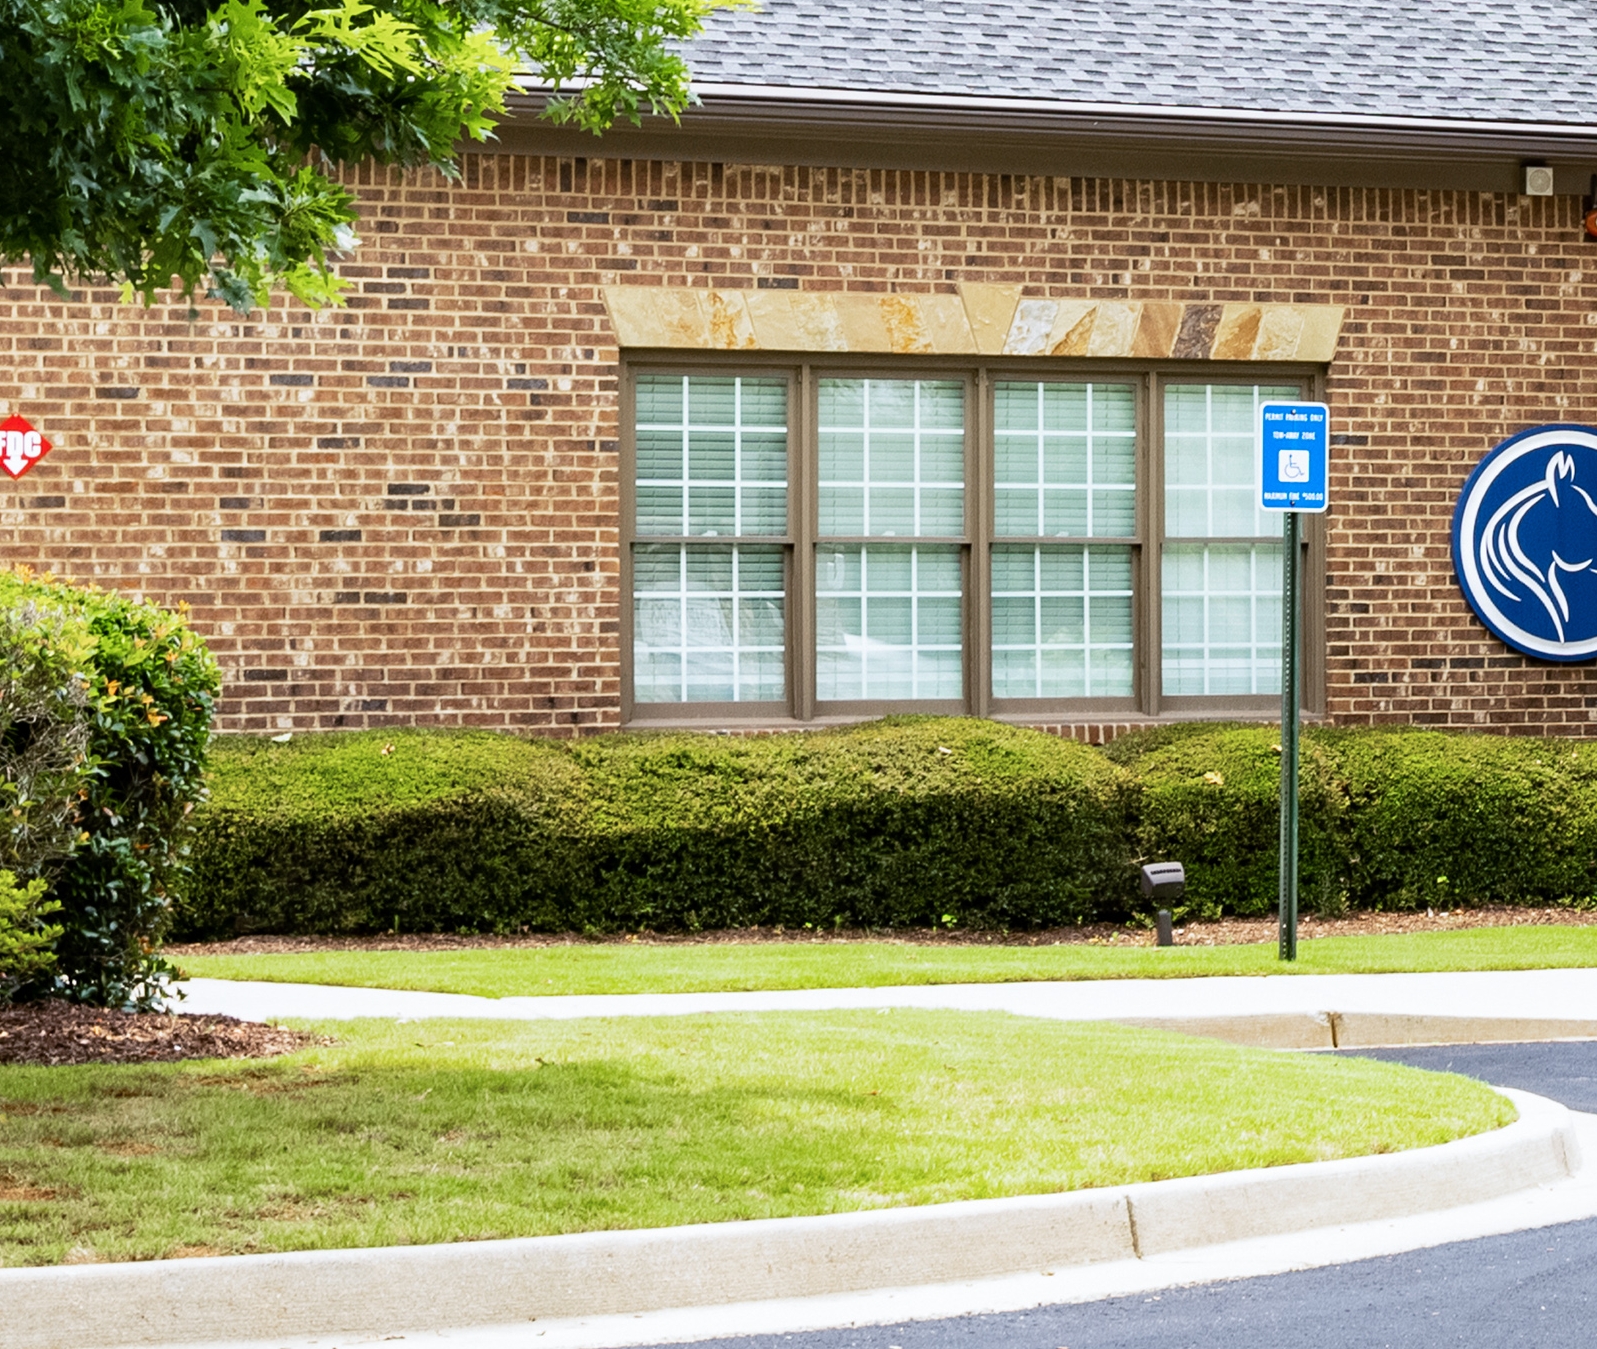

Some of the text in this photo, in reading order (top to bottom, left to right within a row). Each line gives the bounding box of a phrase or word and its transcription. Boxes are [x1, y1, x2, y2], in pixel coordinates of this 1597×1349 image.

[1265, 413, 1283, 421] PERMIT
[1310, 413, 1323, 422] ONLY
[1272, 431, 1315, 440] TOW-AWAY ZONE
